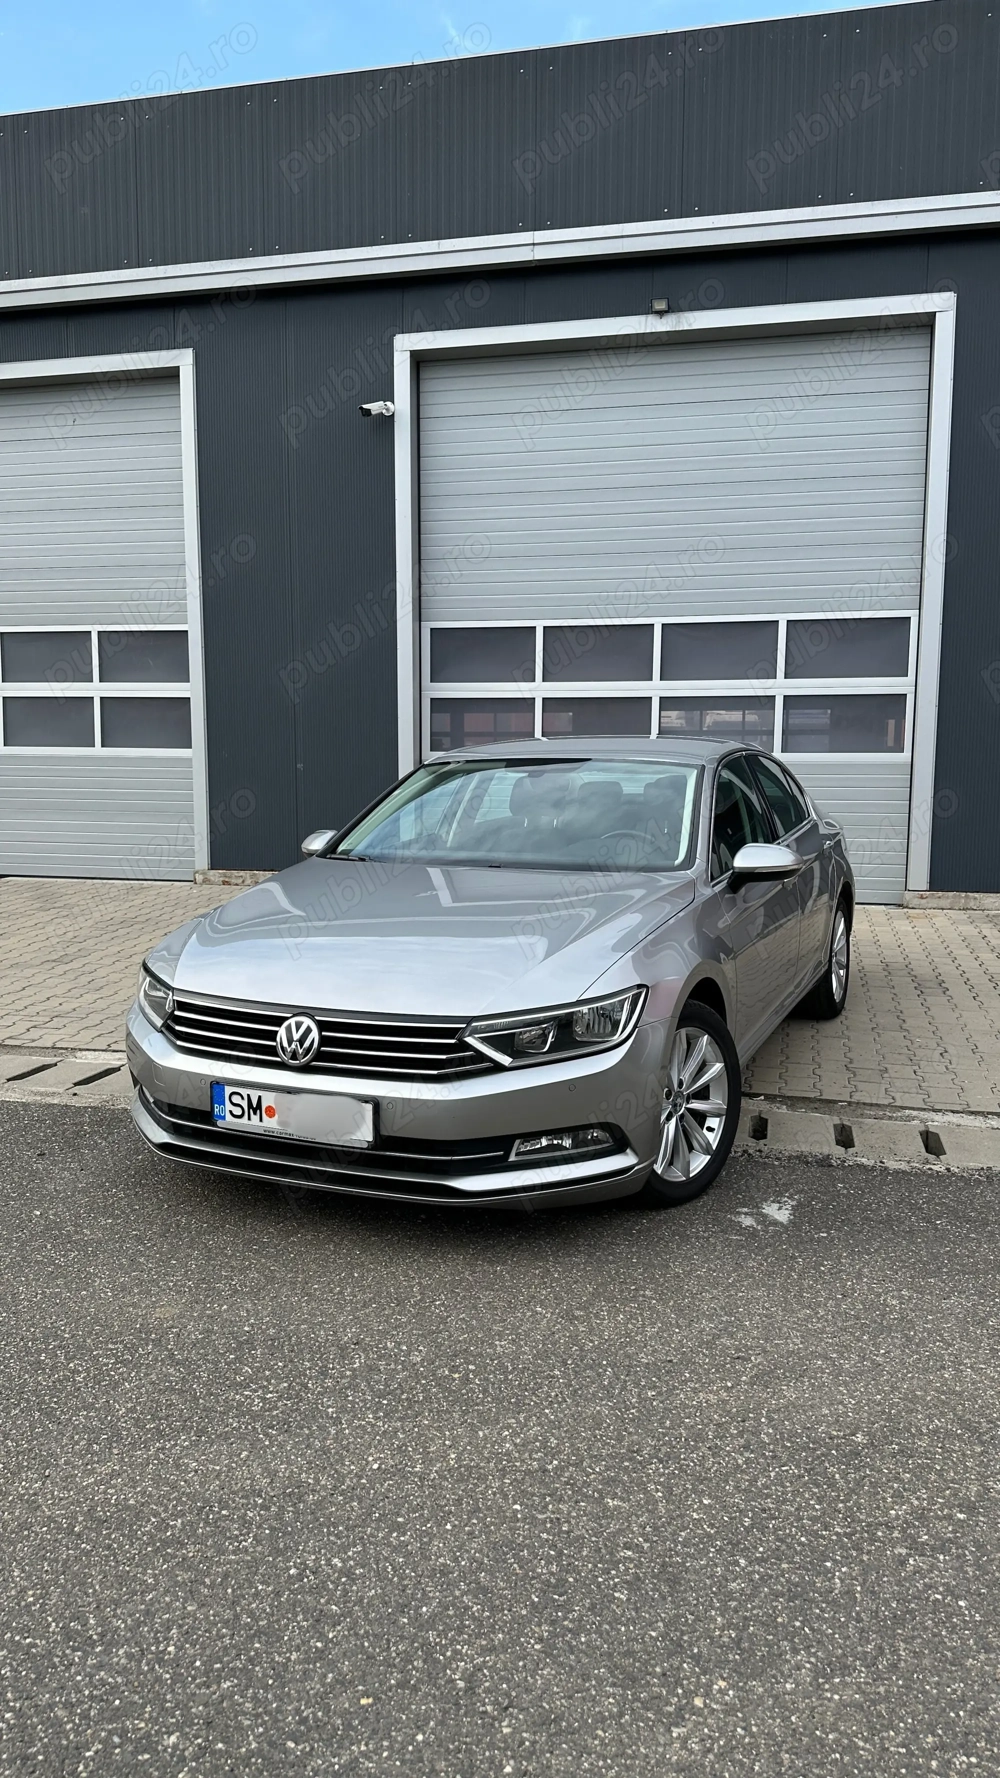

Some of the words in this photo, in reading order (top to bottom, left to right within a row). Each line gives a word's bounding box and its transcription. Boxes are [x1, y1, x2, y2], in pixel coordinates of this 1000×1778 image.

[277, 1015, 318, 1065] VW
[214, 1104, 225, 1116] RO
[228, 1090, 263, 1123] SM
